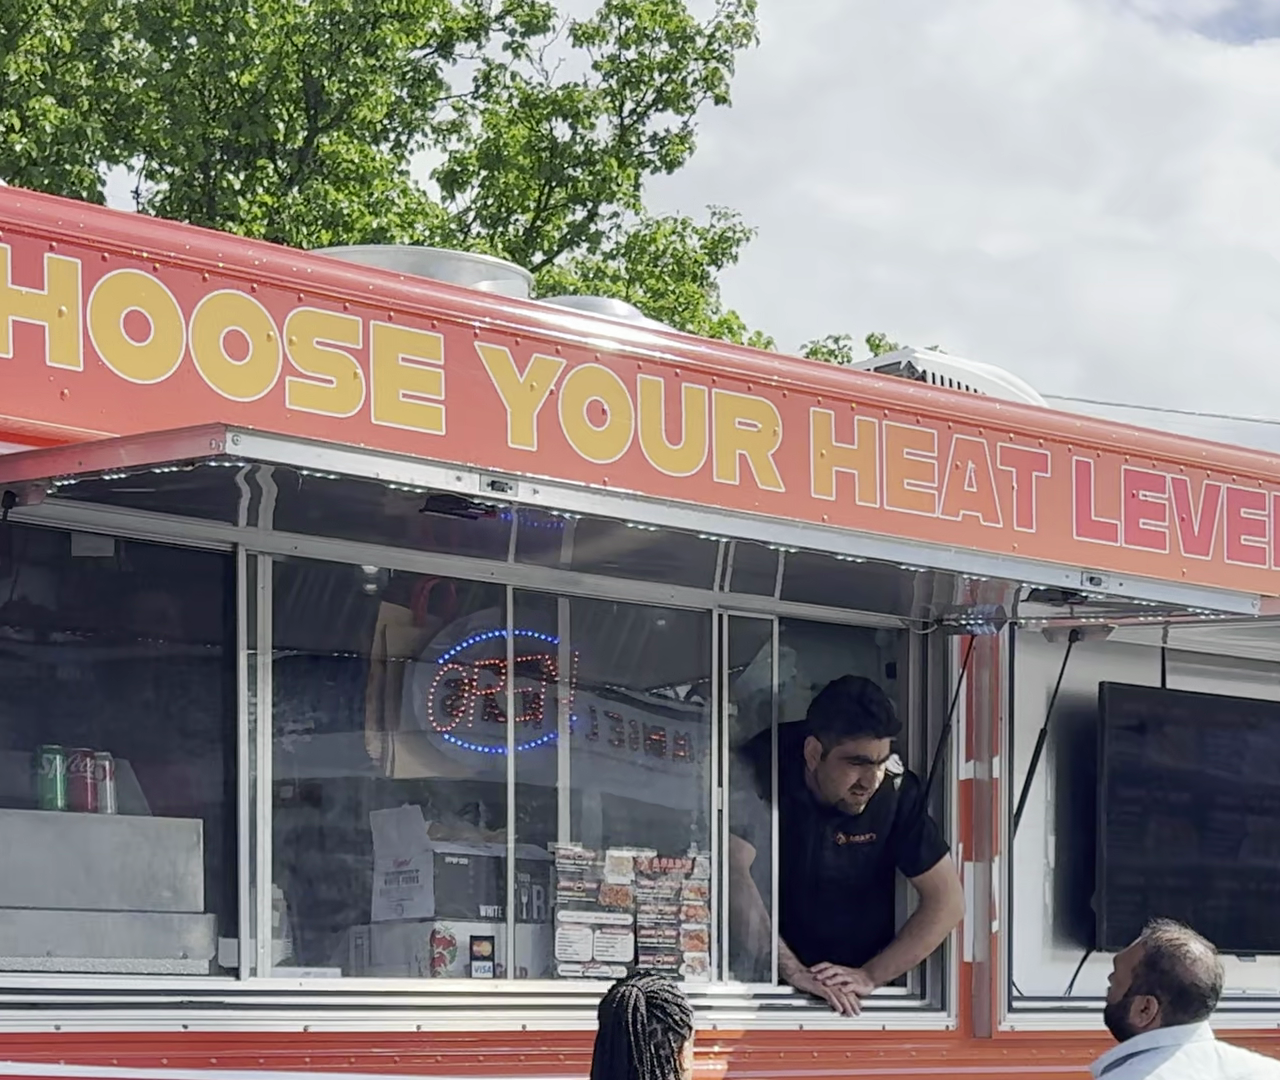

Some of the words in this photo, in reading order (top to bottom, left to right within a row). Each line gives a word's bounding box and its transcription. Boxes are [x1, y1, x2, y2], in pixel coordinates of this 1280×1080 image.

[475, 341, 785, 493] YOUR
[809, 406, 1051, 534] HEAT
[474, 965, 492, 974] VISA
